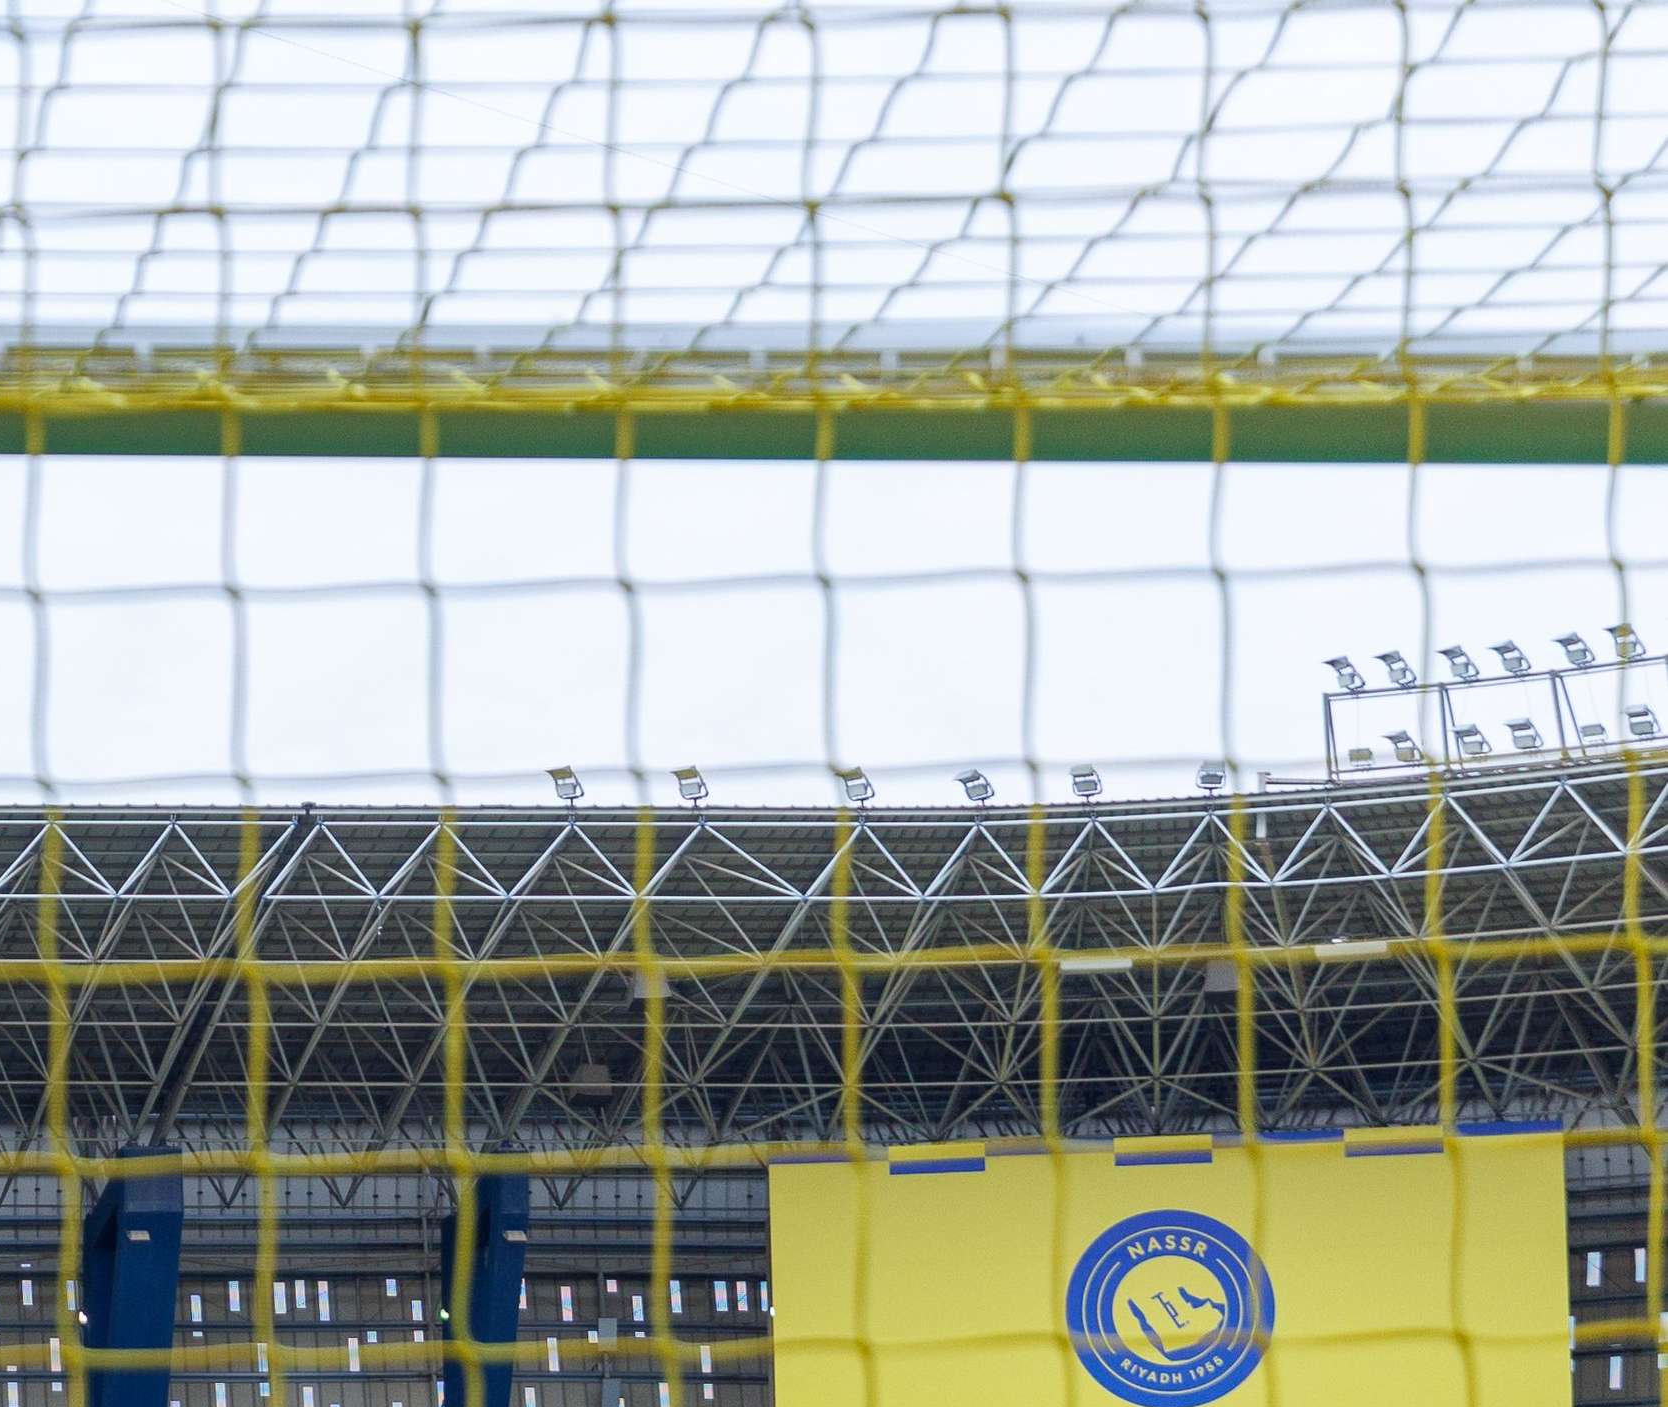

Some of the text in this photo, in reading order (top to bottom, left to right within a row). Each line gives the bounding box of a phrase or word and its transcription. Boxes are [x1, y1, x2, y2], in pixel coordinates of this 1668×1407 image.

[1126, 1234, 1209, 1260] NASSR
[1120, 1355, 1225, 1384] RIYADH 1955
